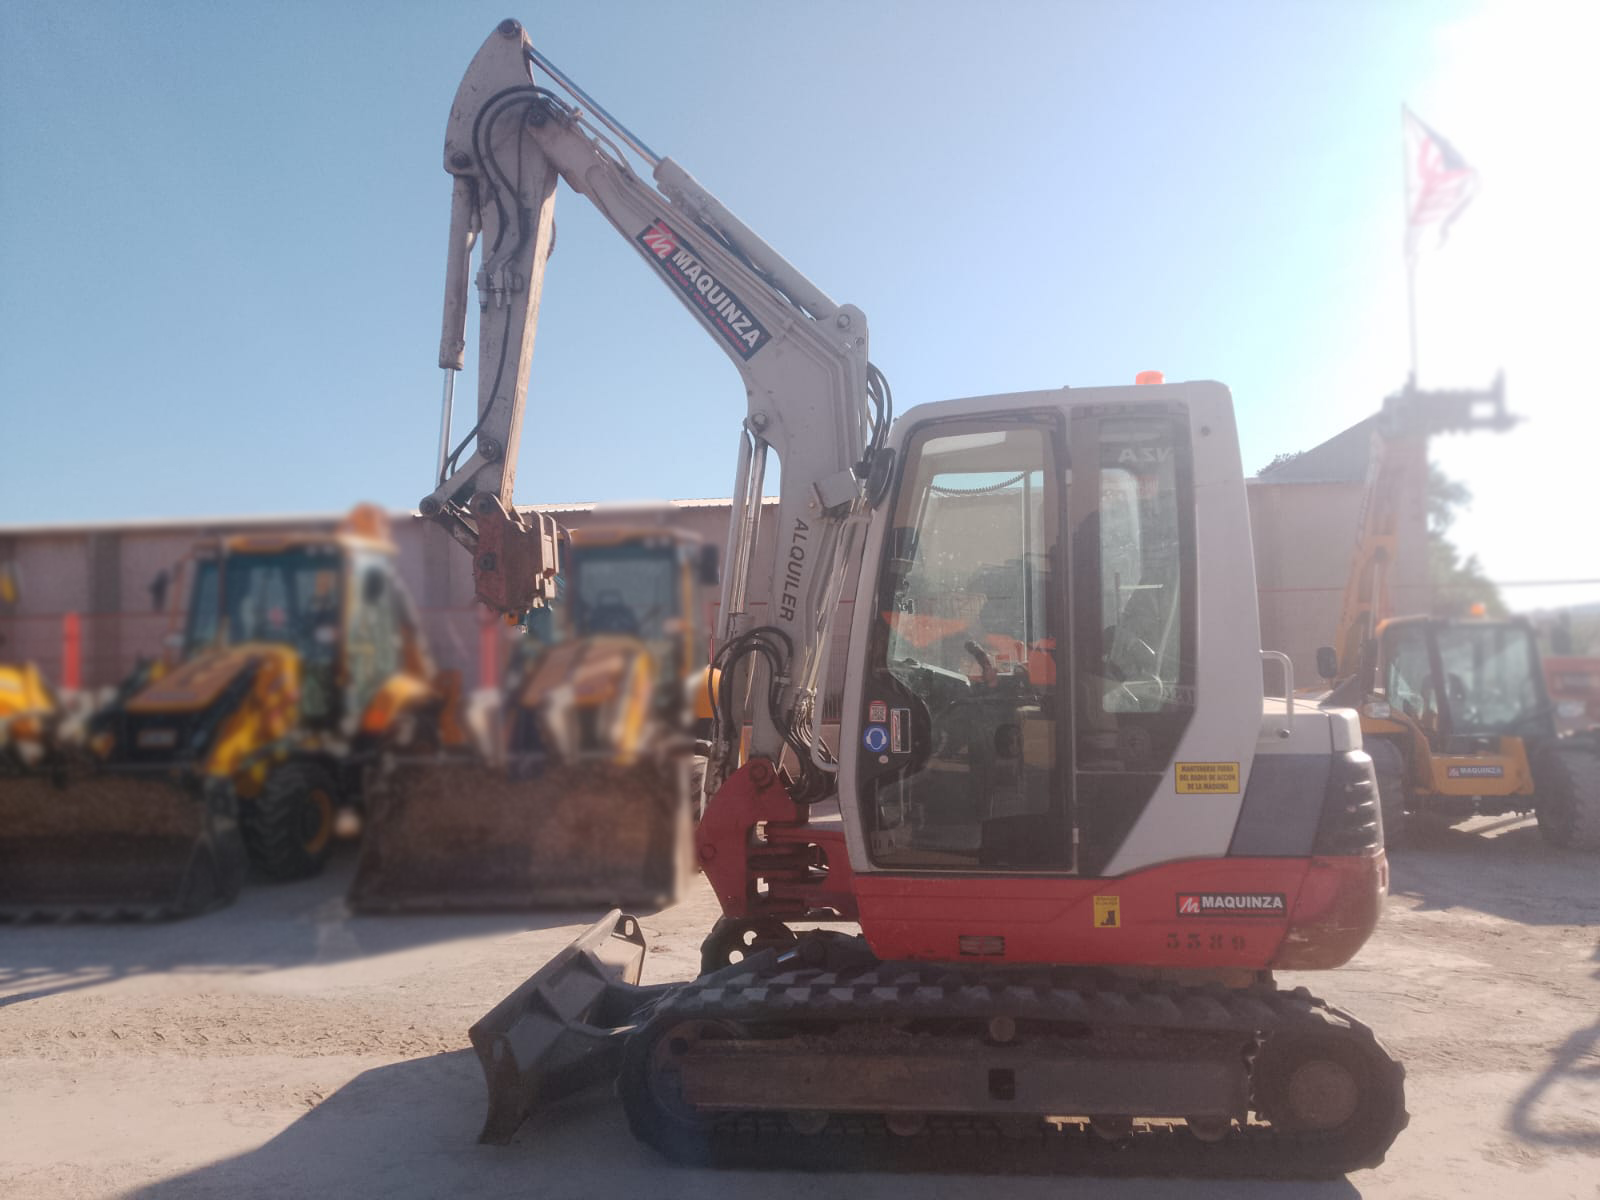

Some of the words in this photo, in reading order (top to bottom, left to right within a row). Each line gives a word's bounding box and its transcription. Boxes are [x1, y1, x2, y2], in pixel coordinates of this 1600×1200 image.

[671, 249, 761, 348] MAQUINZA
[780, 518, 809, 622] ALQUILER
[1202, 896, 1283, 908] MAQUINZA
